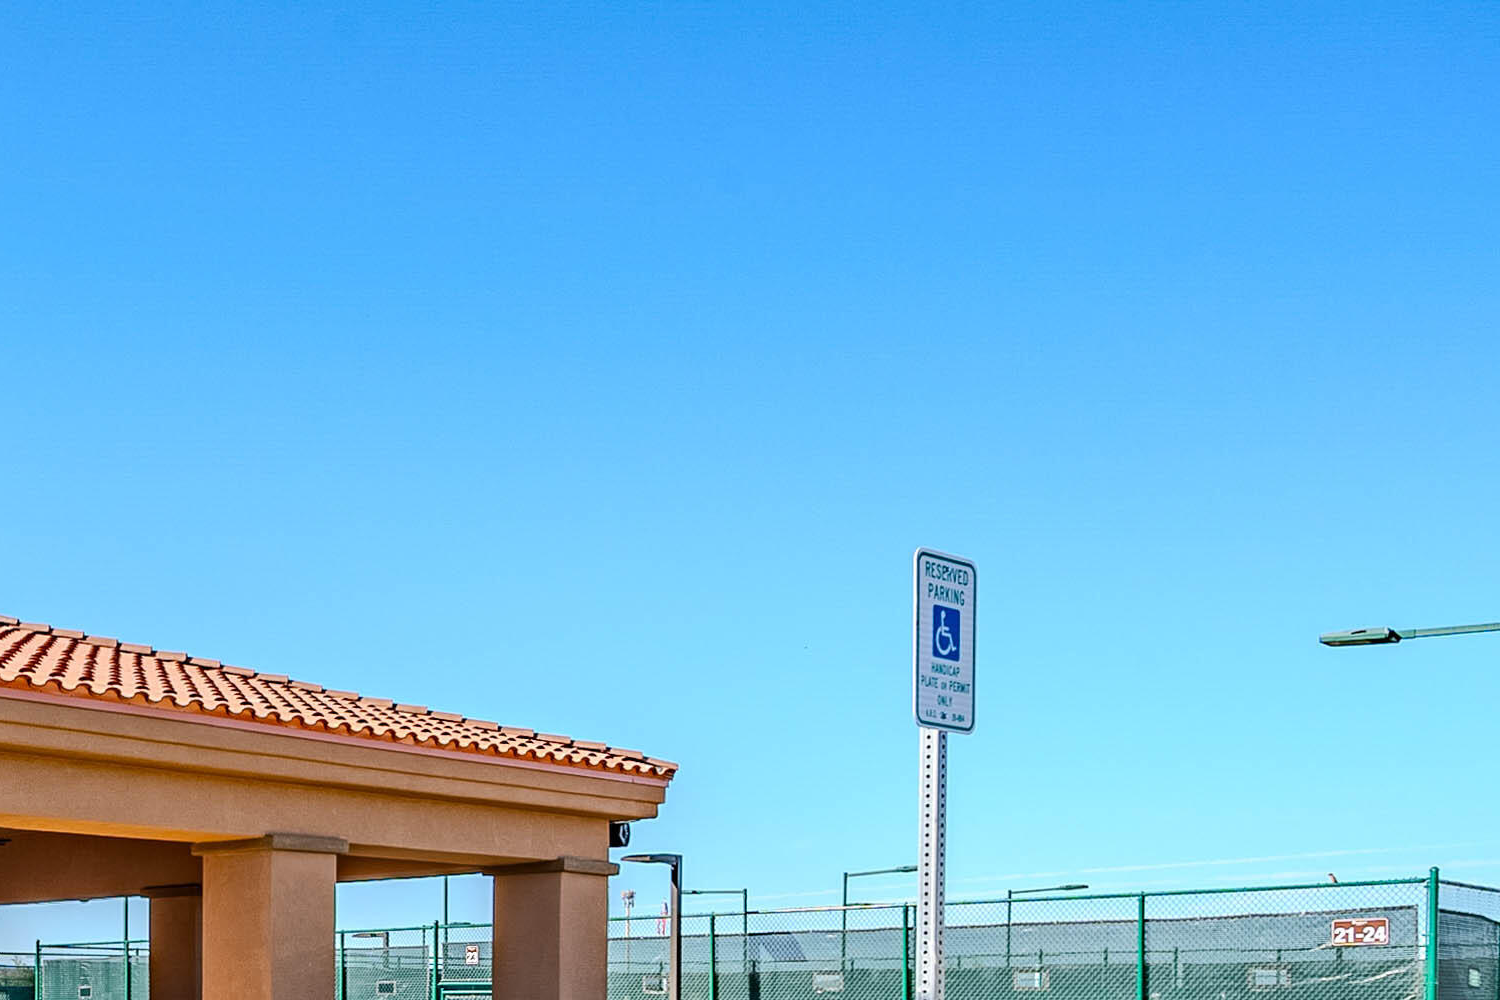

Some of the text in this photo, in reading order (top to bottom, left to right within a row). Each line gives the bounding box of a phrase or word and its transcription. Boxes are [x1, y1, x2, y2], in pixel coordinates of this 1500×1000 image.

[925, 561, 969, 587] RESERVED
[928, 583, 965, 607] PARKING
[921, 675, 938, 689] PLATE
[949, 680, 970, 694] PERMIT
[1334, 926, 1386, 943] 21-24
